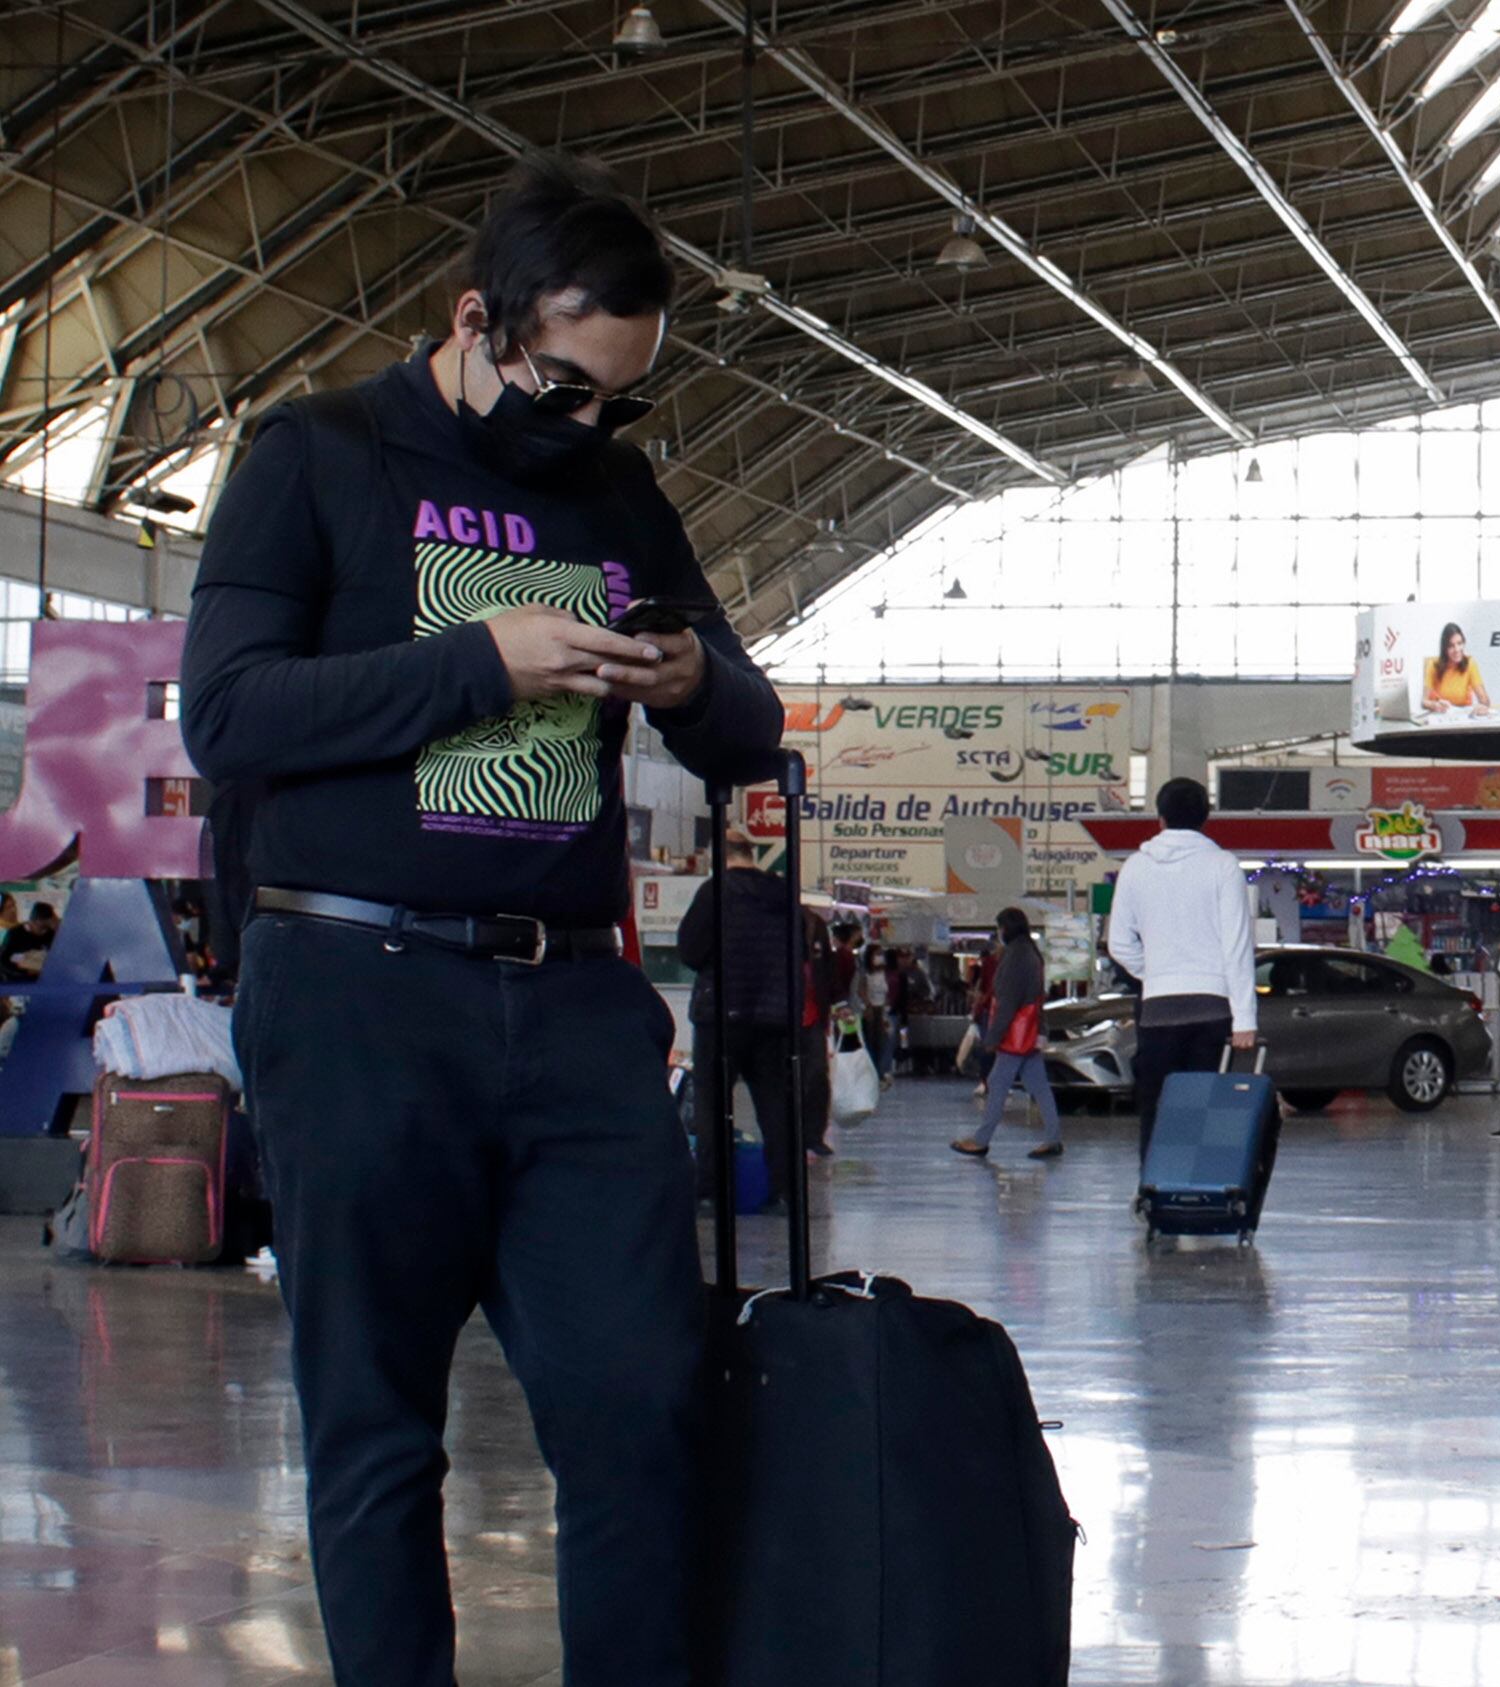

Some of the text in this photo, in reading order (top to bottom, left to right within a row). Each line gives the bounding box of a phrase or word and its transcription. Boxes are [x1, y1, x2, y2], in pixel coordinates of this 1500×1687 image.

[413, 500, 536, 554] ACID
[874, 705, 1004, 730] VERDES
[1045, 753, 1113, 776] SUR
[799, 794, 886, 820] Salida
[896, 794, 931, 820] de
[833, 822, 868, 837] Solo
[829, 846, 907, 860] Departure
[832, 862, 899, 873] PASSENGERS
